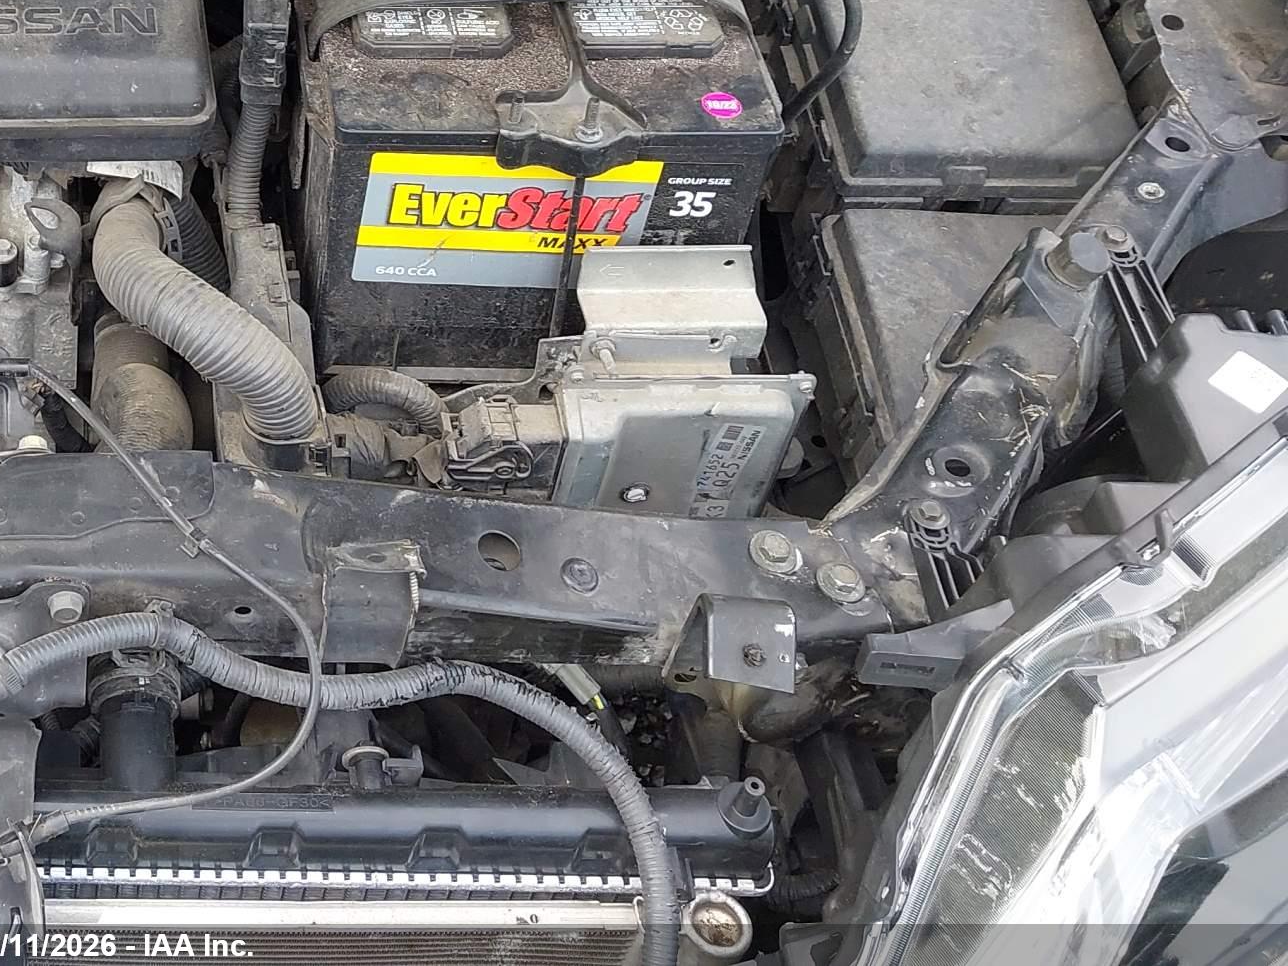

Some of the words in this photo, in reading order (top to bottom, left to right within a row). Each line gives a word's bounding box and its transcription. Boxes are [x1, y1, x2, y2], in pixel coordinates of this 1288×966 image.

[667, 178, 706, 186] GROUP
[707, 178, 732, 186] SIZE
[387, 183, 644, 232] EverStart
[669, 191, 716, 217] 35
[375, 266, 405, 275] 640
[407, 267, 437, 277] CCA
[737, 430, 761, 461] NISSAN
